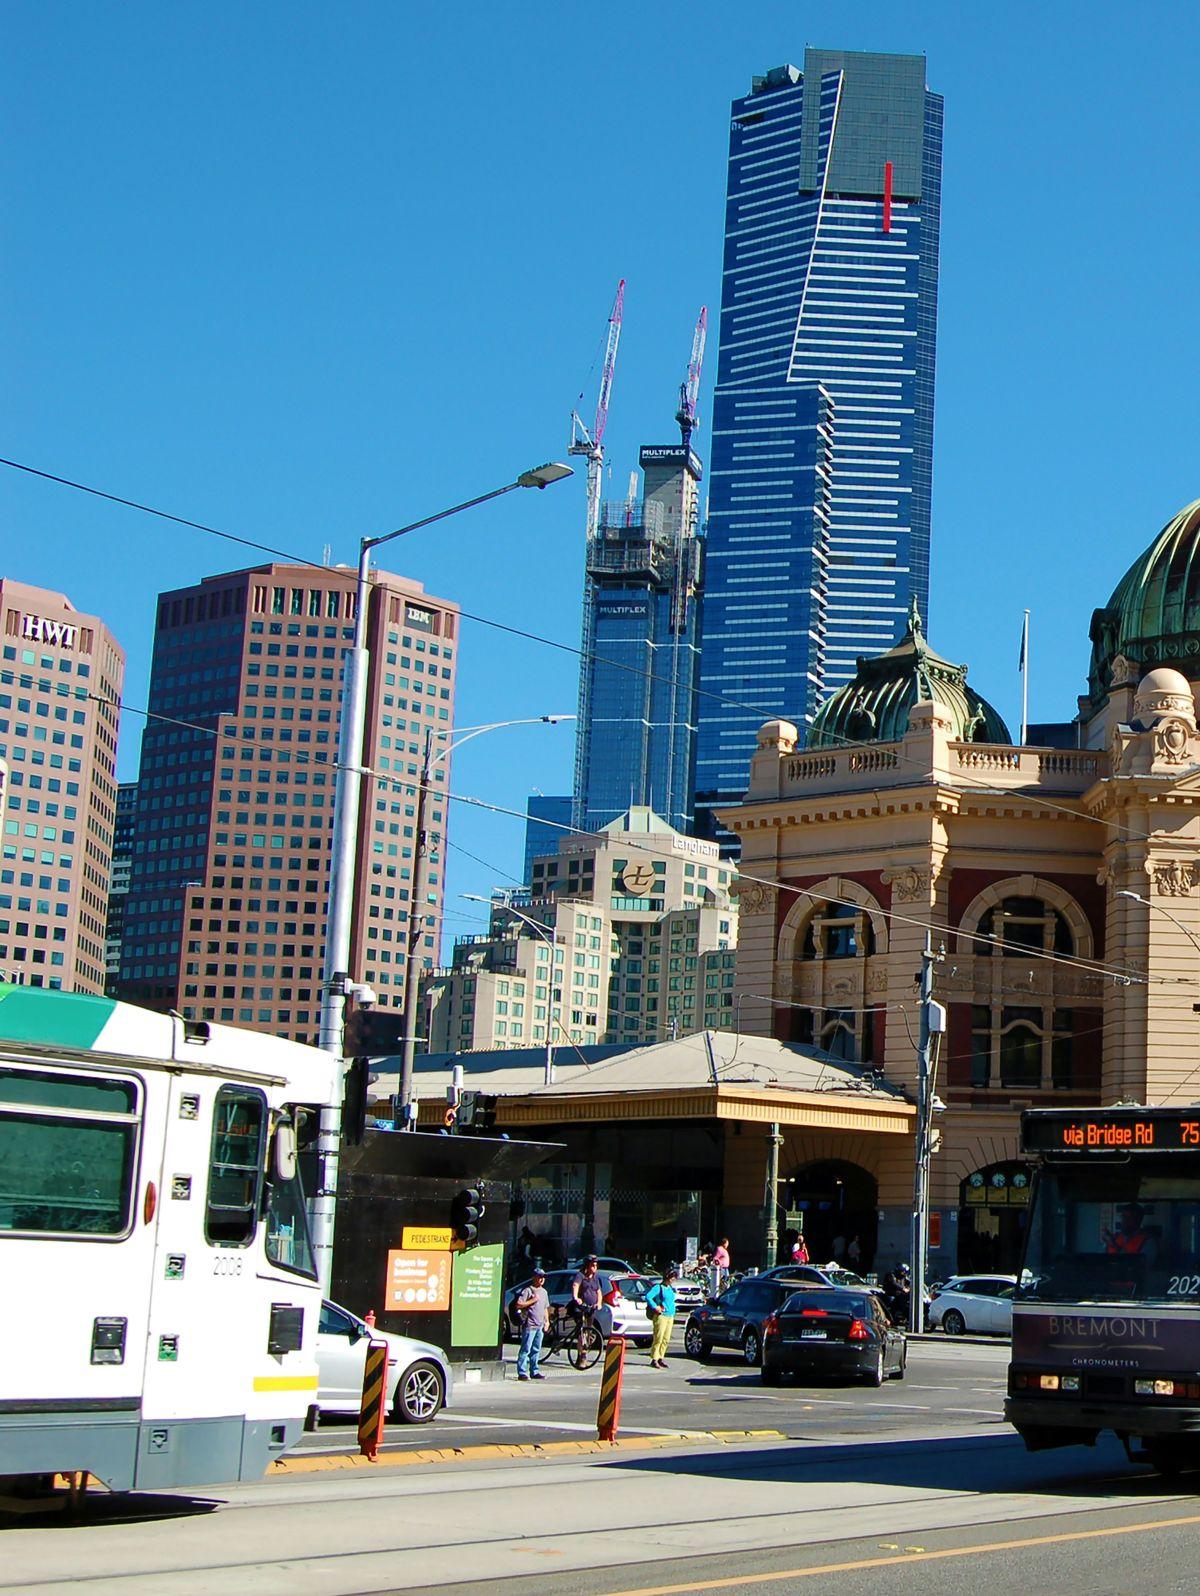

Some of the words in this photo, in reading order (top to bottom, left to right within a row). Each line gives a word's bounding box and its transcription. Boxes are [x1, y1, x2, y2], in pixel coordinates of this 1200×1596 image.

[408, 607, 430, 624] IBM
[599, 606, 647, 614] MULTIPLEX
[23, 614, 78, 646] HWT
[673, 835, 719, 857] Langham
[1064, 1125, 1084, 1145] via
[1087, 1124, 1132, 1147] Bridge
[1135, 1123, 1153, 1144] Rd
[1180, 1123, 1200, 1144] 75
[213, 1256, 242, 1276] 2008
[1048, 1317, 1160, 1338] BREMONT
[1072, 1358, 1140, 1368] CHRONOMETERS
